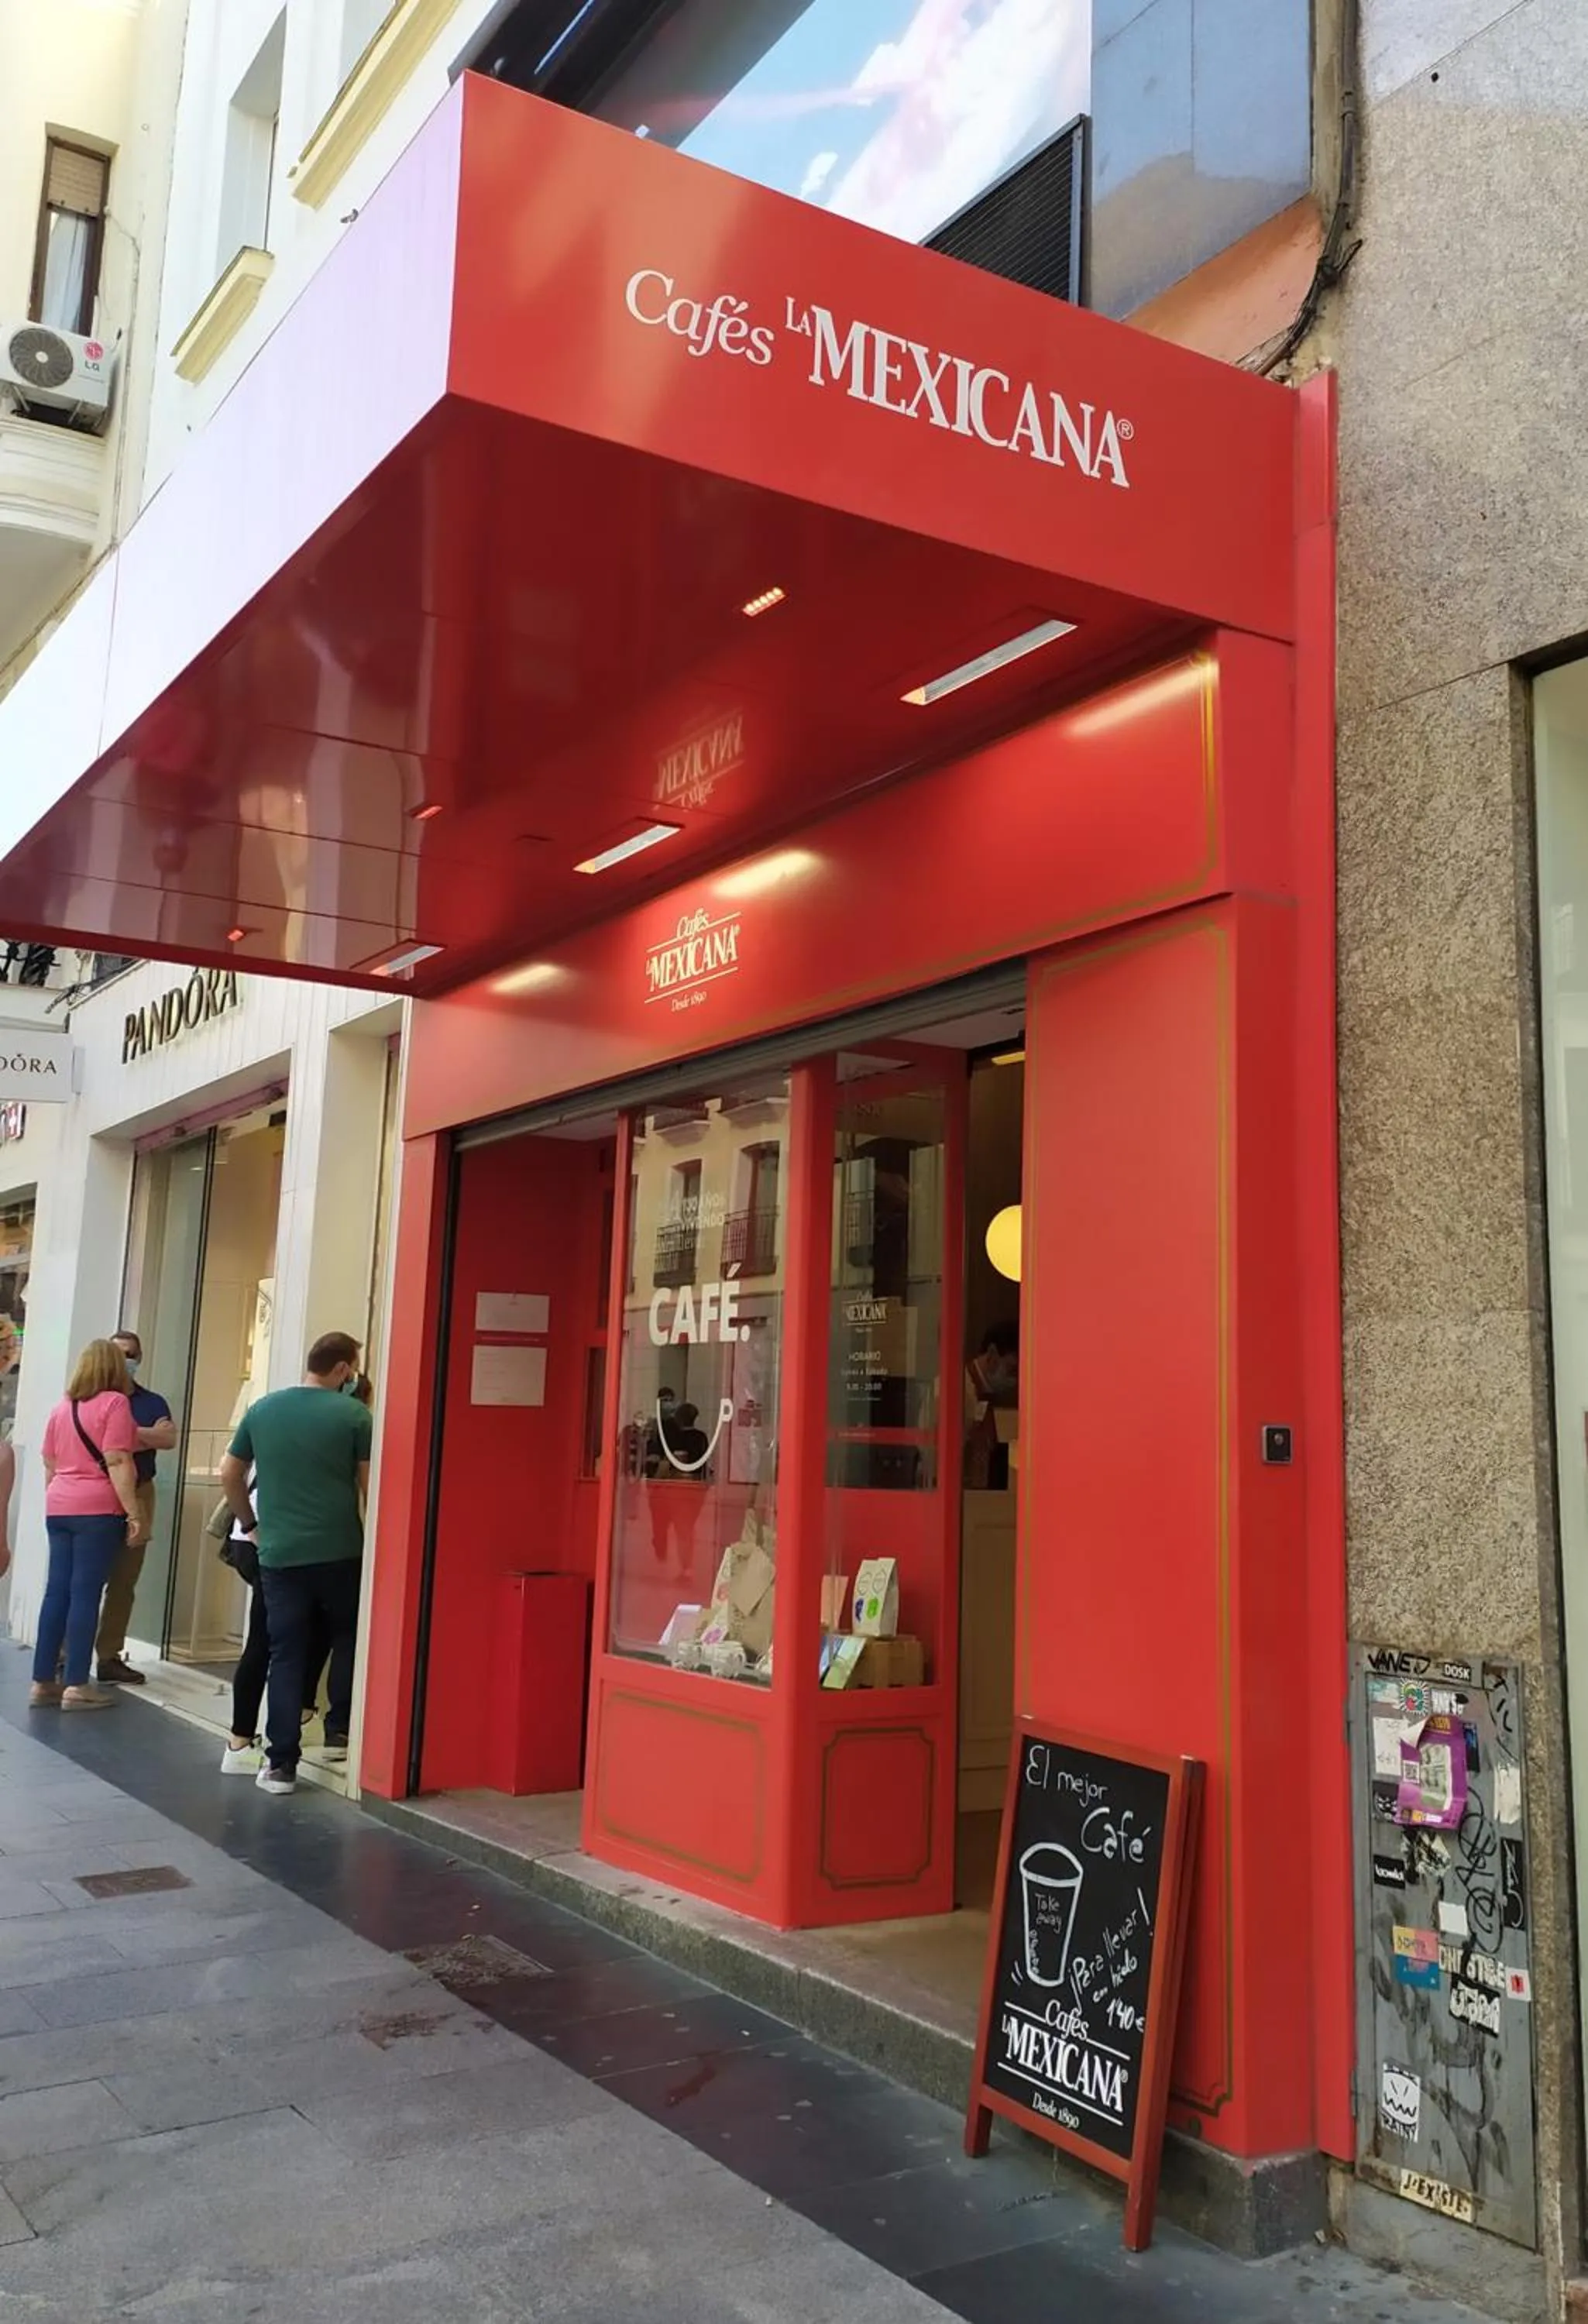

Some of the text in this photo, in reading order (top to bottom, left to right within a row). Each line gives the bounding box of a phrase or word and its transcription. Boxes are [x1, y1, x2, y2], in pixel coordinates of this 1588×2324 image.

[625, 270, 774, 365] Cafés
[785, 297, 812, 336] LA
[1026, 1745, 1109, 1807] El mejor
[1081, 1807, 1151, 1863] Café
[1046, 1999, 1089, 2040] Cafés
